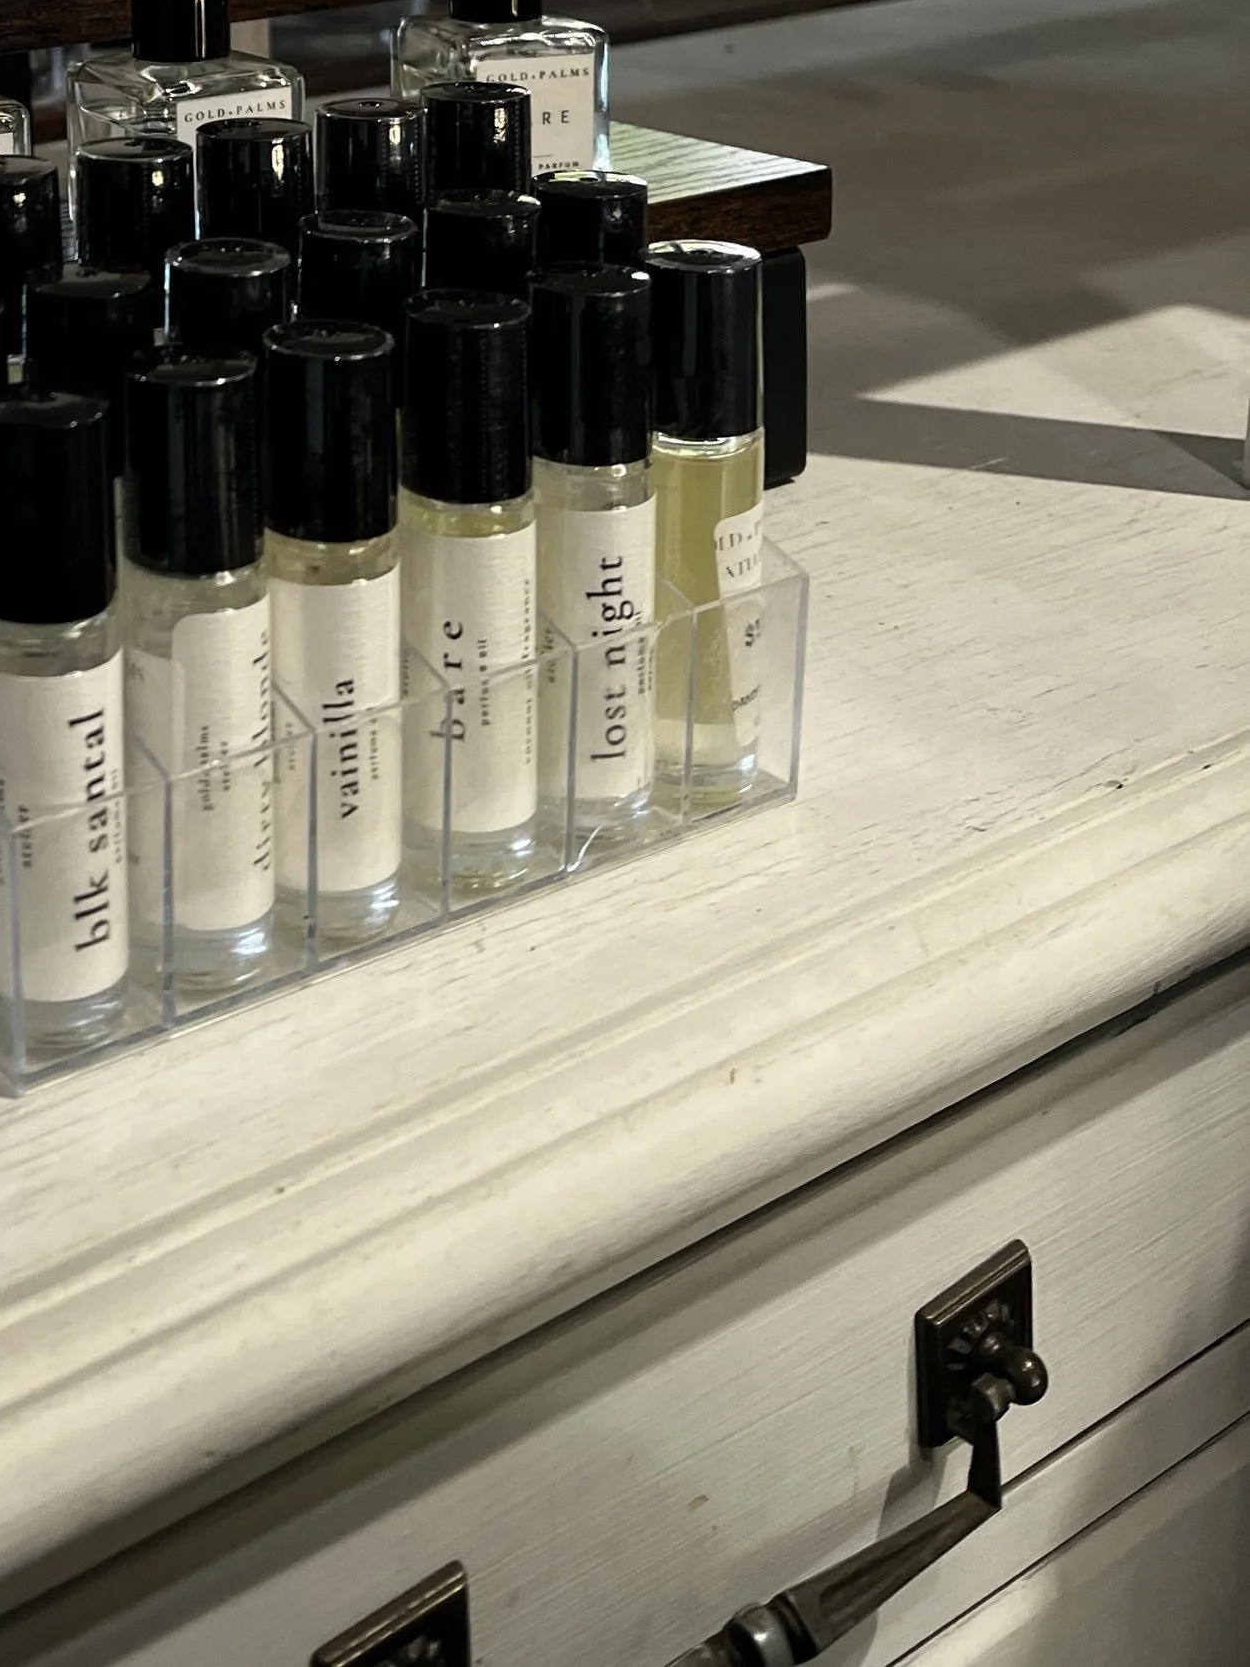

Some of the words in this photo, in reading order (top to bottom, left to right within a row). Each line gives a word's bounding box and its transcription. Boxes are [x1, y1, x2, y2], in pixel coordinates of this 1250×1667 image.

[538, 161, 580, 170] PARFUM
[584, 555, 635, 670] night
[428, 620, 468, 743] bare
[588, 684, 628, 763] lost
[67, 708, 109, 853] santal
[320, 677, 361, 820] vainilla
[72, 868, 111, 952] blk
